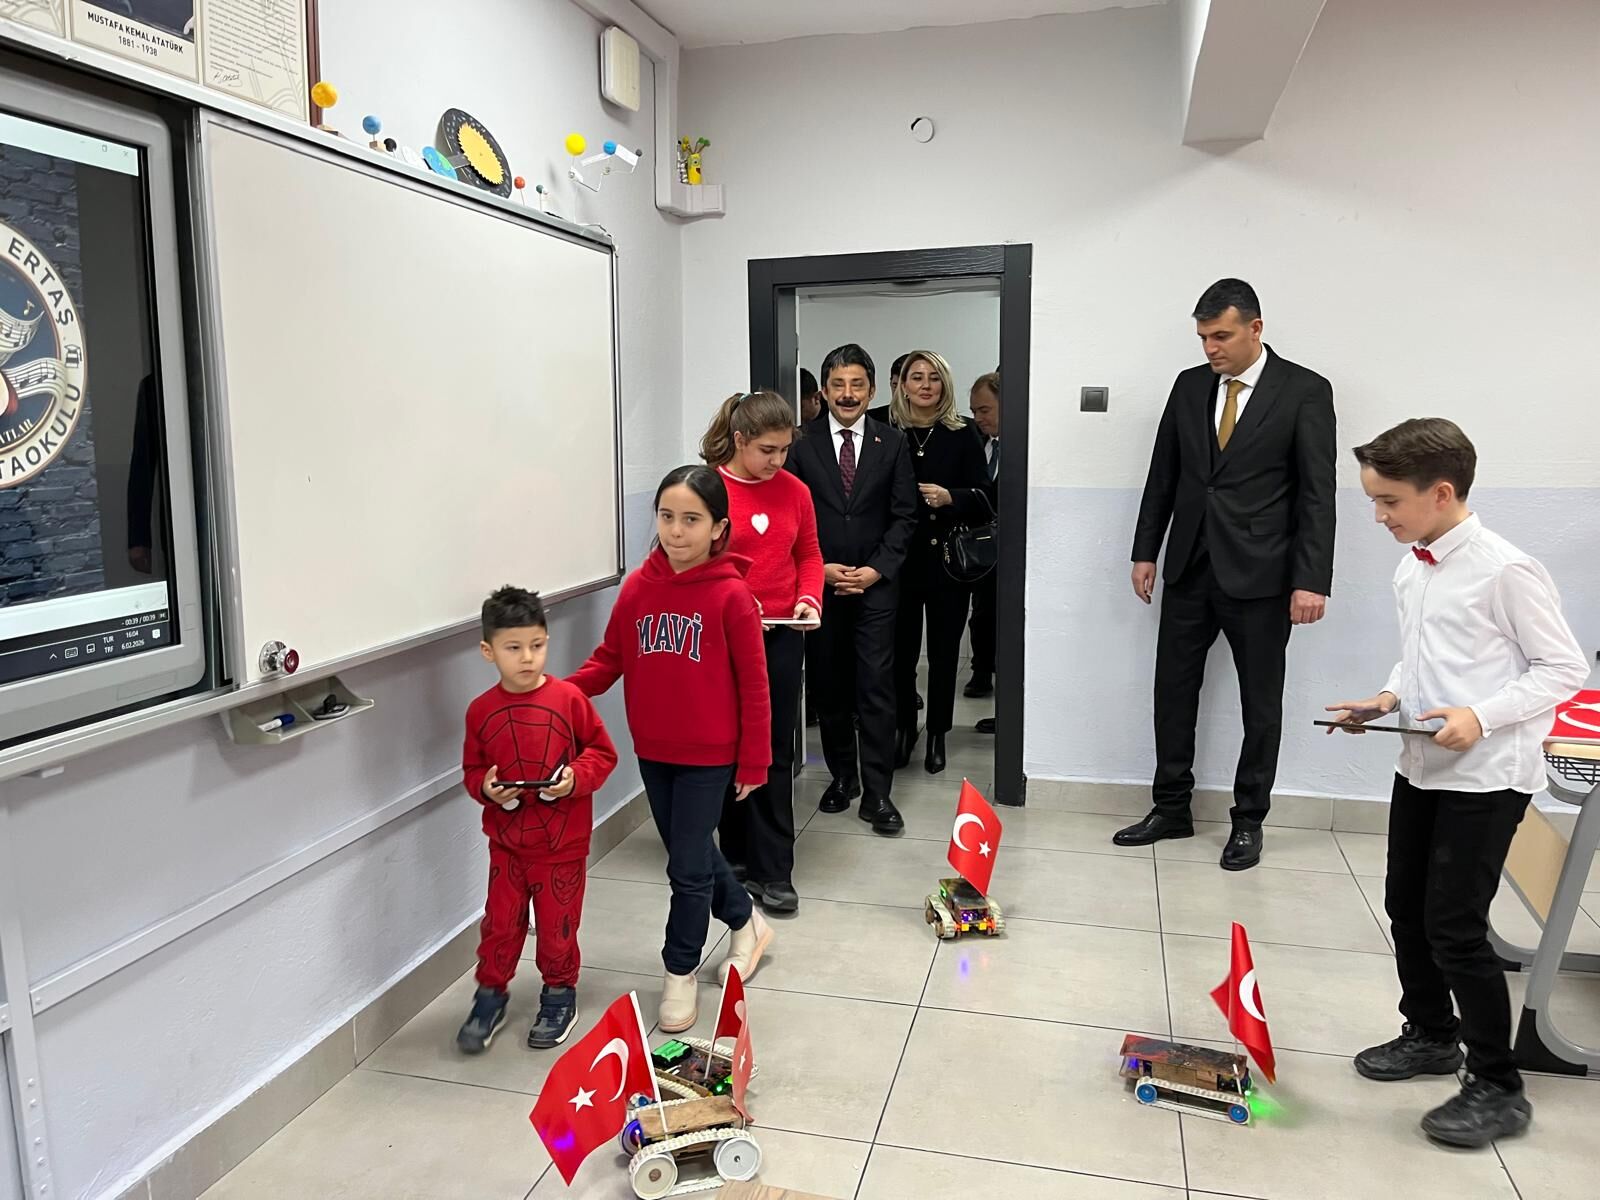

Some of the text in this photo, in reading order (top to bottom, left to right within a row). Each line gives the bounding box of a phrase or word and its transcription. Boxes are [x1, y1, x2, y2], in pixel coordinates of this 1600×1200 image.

[87, 11, 184, 54] MUSTAFA KEMAL ATATÜRK
[119, 36, 135, 49] 1881
[142, 44, 158, 57] 1938
[8, 237, 74, 325] ERTAŞ
[636, 612, 703, 662] MAVİ
